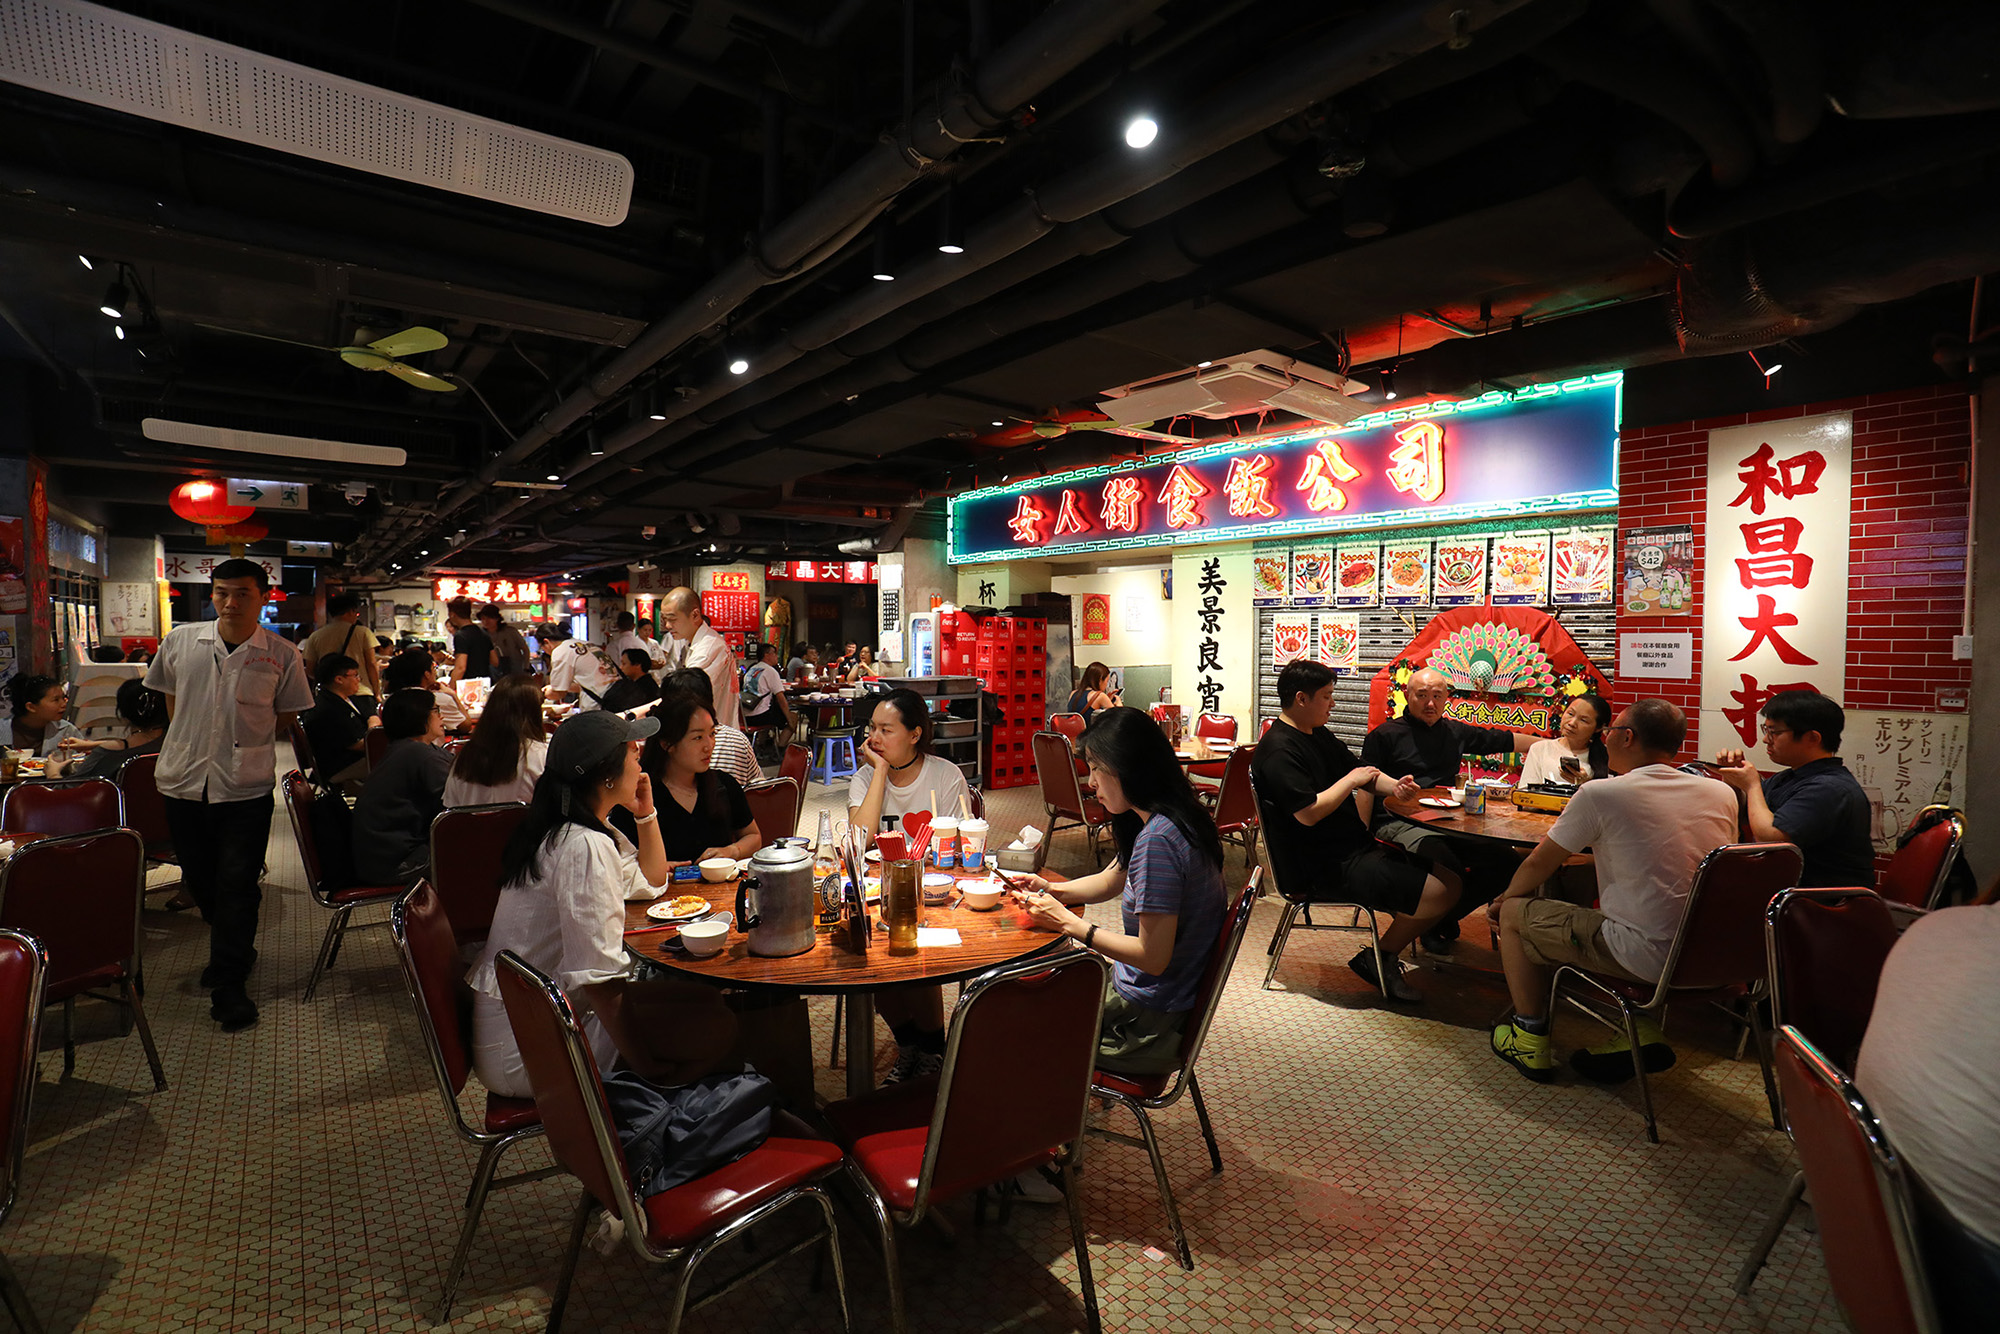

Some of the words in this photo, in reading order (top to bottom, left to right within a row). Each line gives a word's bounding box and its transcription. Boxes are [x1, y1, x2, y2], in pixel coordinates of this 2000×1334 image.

[1008, 421, 1444, 542] 女人街食飯公司
[166, 557, 277, 581] 水哥魚
[1641, 557, 1660, 565] $42
[436, 577, 542, 602] 歡迎光臨
[978, 579, 996, 605] 杯
[1197, 557, 1227, 717] 美景良宵
[1875, 717, 1892, 754] モルツ
[1920, 719, 1933, 764] サントリー
